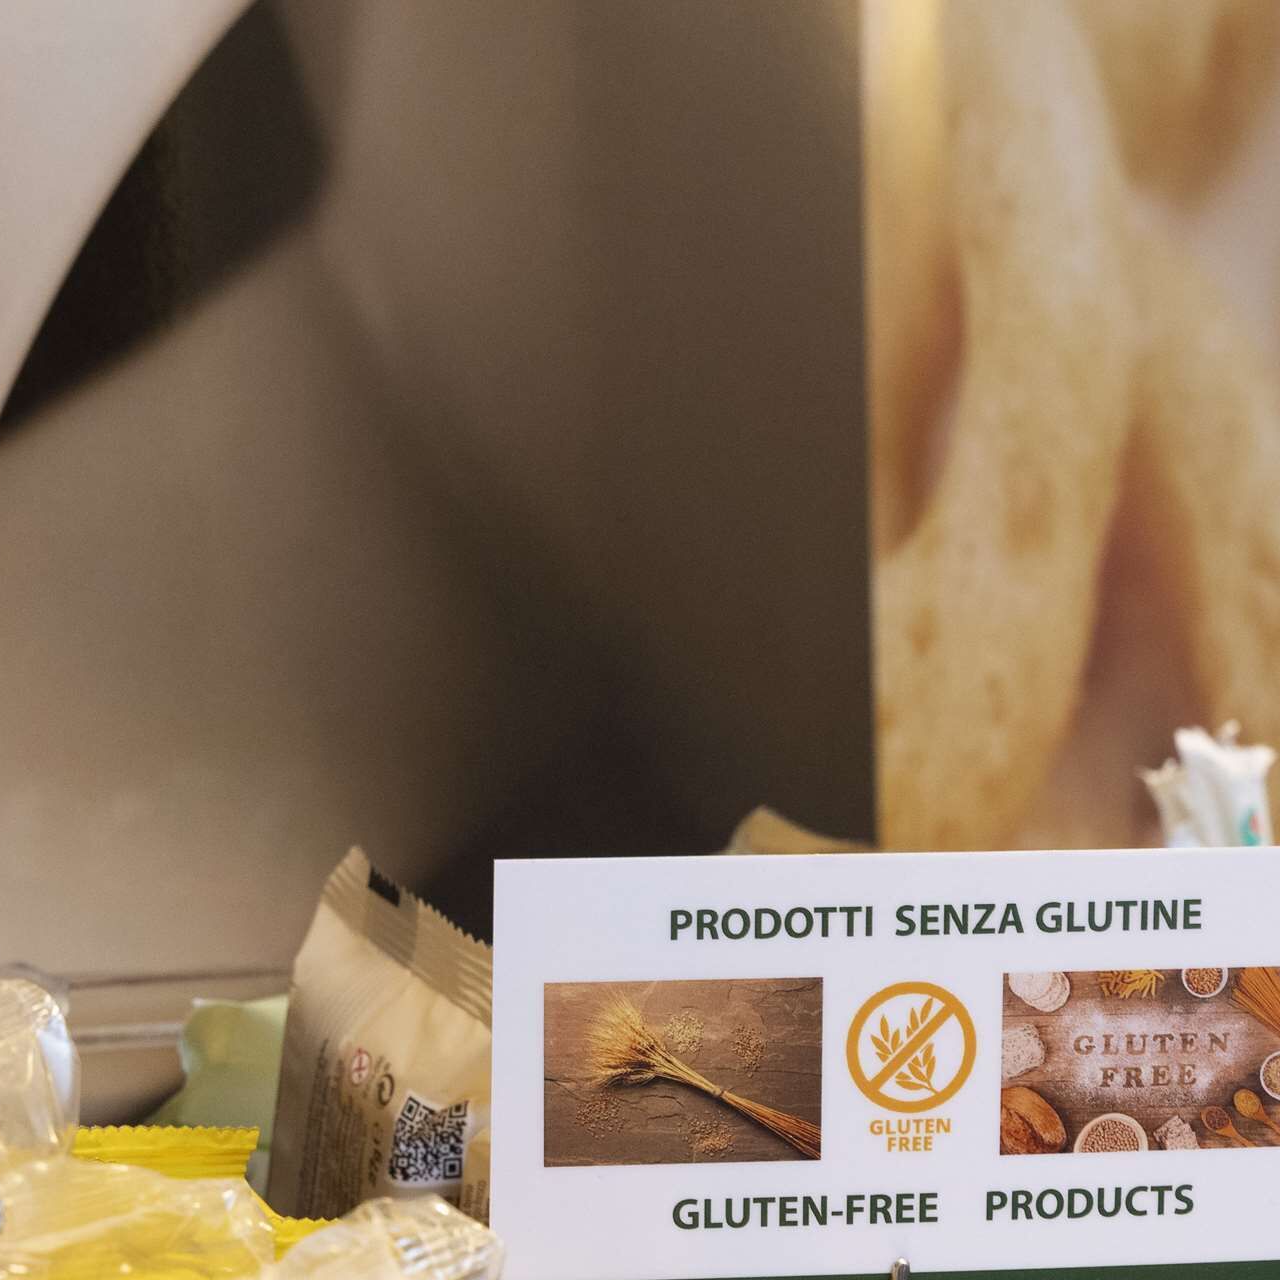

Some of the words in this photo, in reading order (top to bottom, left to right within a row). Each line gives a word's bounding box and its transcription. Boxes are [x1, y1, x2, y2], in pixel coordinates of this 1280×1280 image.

[670, 905, 873, 941] PRODOTTI
[895, 903, 1025, 937] SENZA
[1035, 898, 1202, 934] GLUTINE
[1073, 1033, 1230, 1056] GLUTEN
[1099, 1064, 1197, 1088] FREE
[869, 1118, 951, 1136] GLUTEN
[887, 1136, 933, 1152] FREE
[672, 1192, 939, 1230] GLUTEN-FREE
[985, 1184, 1194, 1221] PRODUCTS
